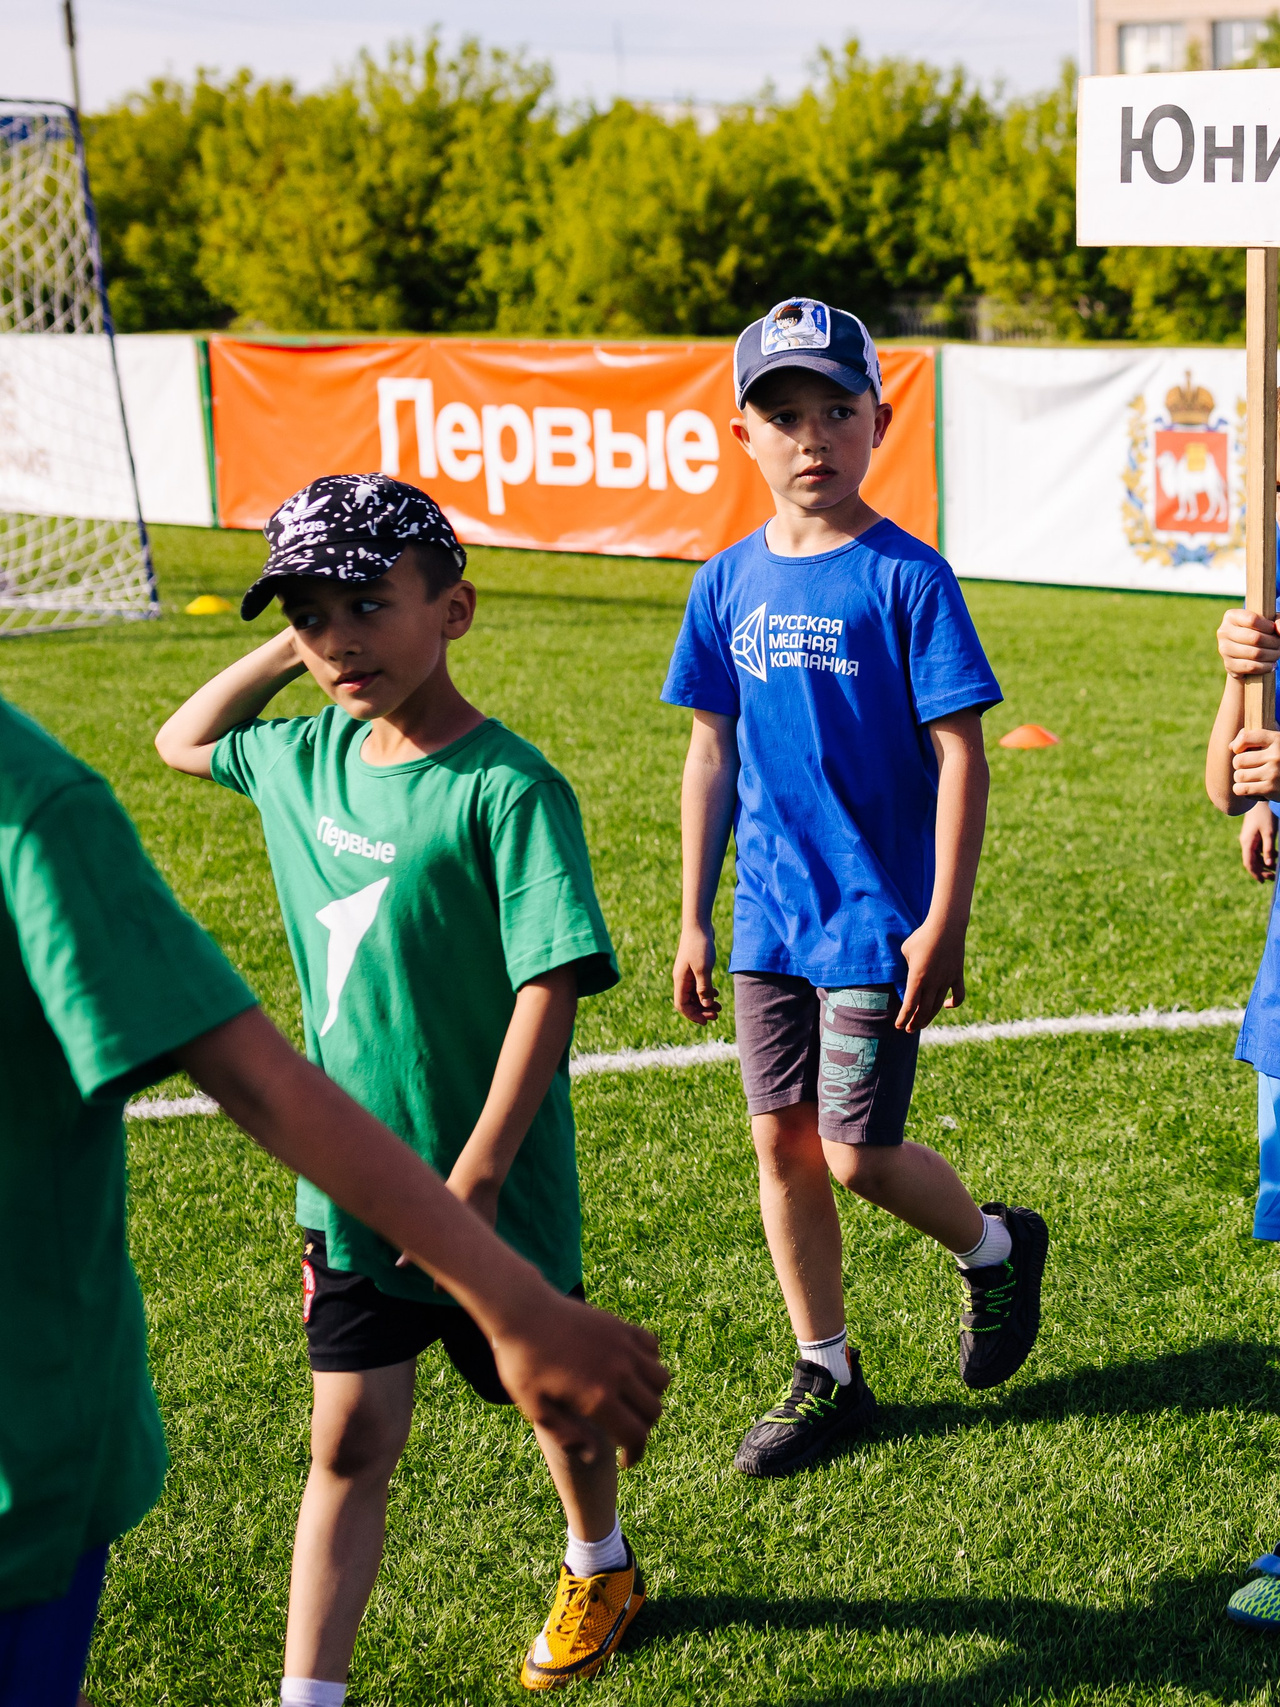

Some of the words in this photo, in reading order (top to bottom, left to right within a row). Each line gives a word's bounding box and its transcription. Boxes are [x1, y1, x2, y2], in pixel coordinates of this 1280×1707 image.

[377, 377, 720, 515] Первые
[768, 614, 844, 635] РУССКАЯ
[768, 633, 838, 653] МЕДНАЯ
[770, 651, 859, 677] КОМПАНИЯ
[316, 815, 397, 864] Первые
